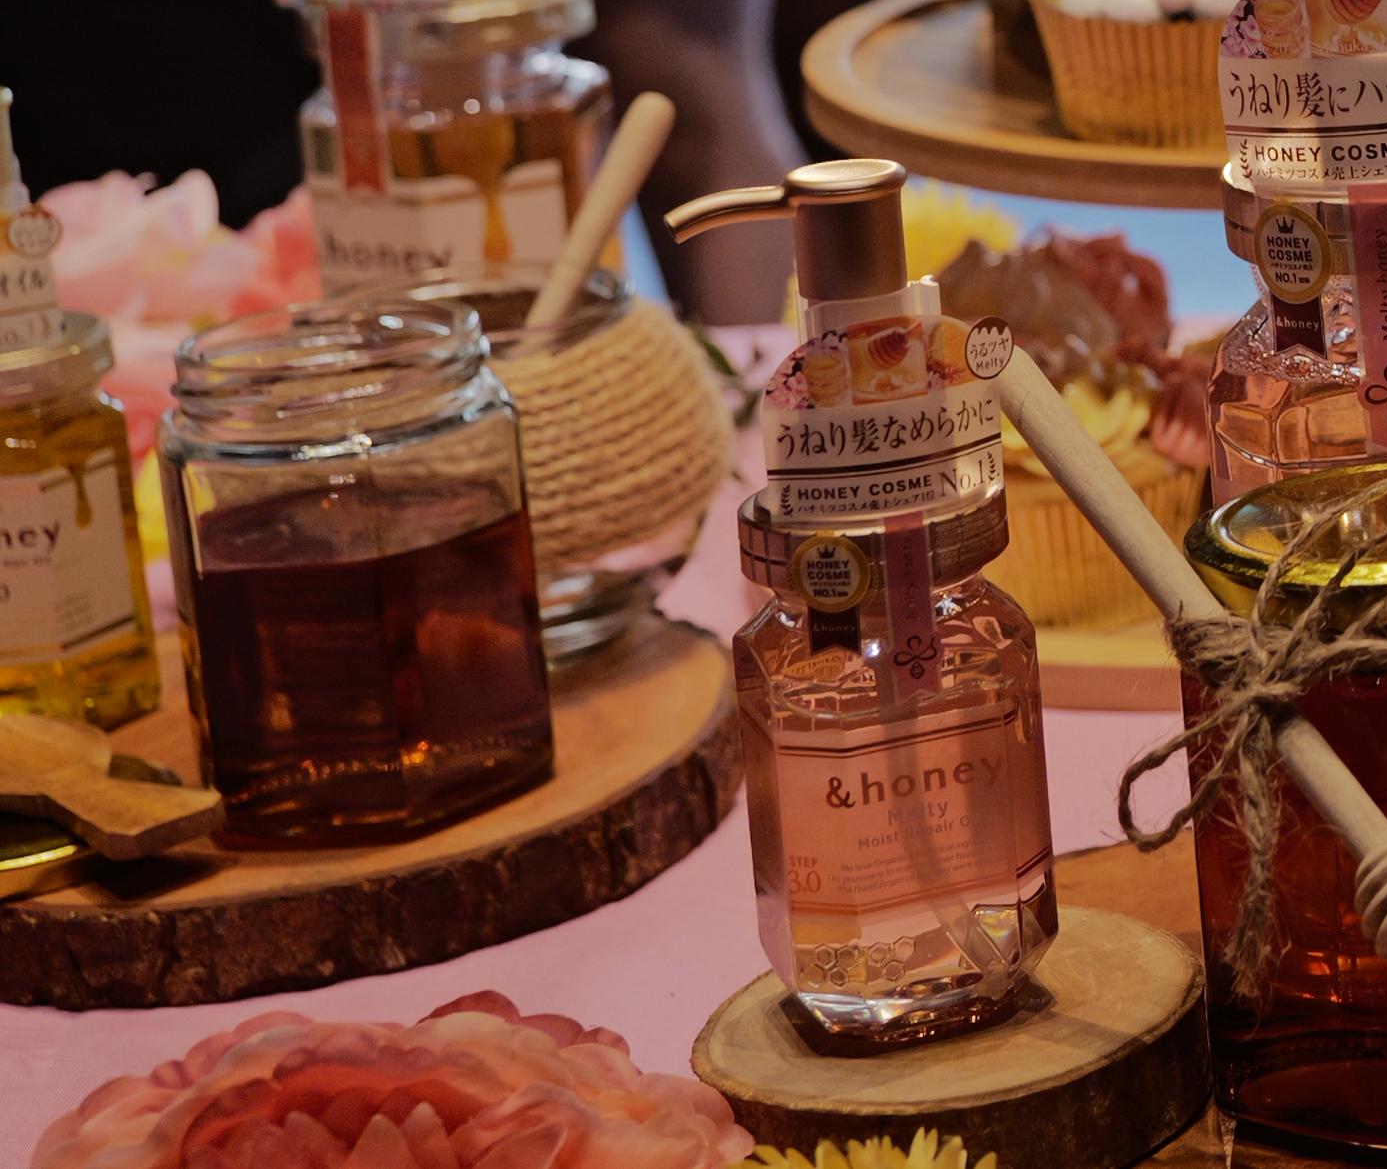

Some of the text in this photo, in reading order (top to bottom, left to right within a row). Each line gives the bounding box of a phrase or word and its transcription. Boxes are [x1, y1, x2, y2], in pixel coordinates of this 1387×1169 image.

[1254, 145, 1321, 163] HONEY
[1266, 235, 1310, 250] HONEY
[1268, 248, 1313, 263] COSME
[1275, 271, 1297, 284] NO.1
[1276, 317, 1321, 330] &honey
[969, 337, 1010, 358] うるツヤ
[975, 355, 1005, 372] Melty
[776, 397, 995, 460] うねり髪なめらかに
[797, 460, 986, 502] HONEY COSME No.1
[806, 559, 850, 570] HONEY
[807, 570, 851, 581] COSME
[825, 758, 1001, 809] &honey
[888, 801, 948, 828] Mty
[858, 831, 900, 851] Moist
[788, 856, 818, 869] STEP
[788, 869, 822, 894] 3.0
